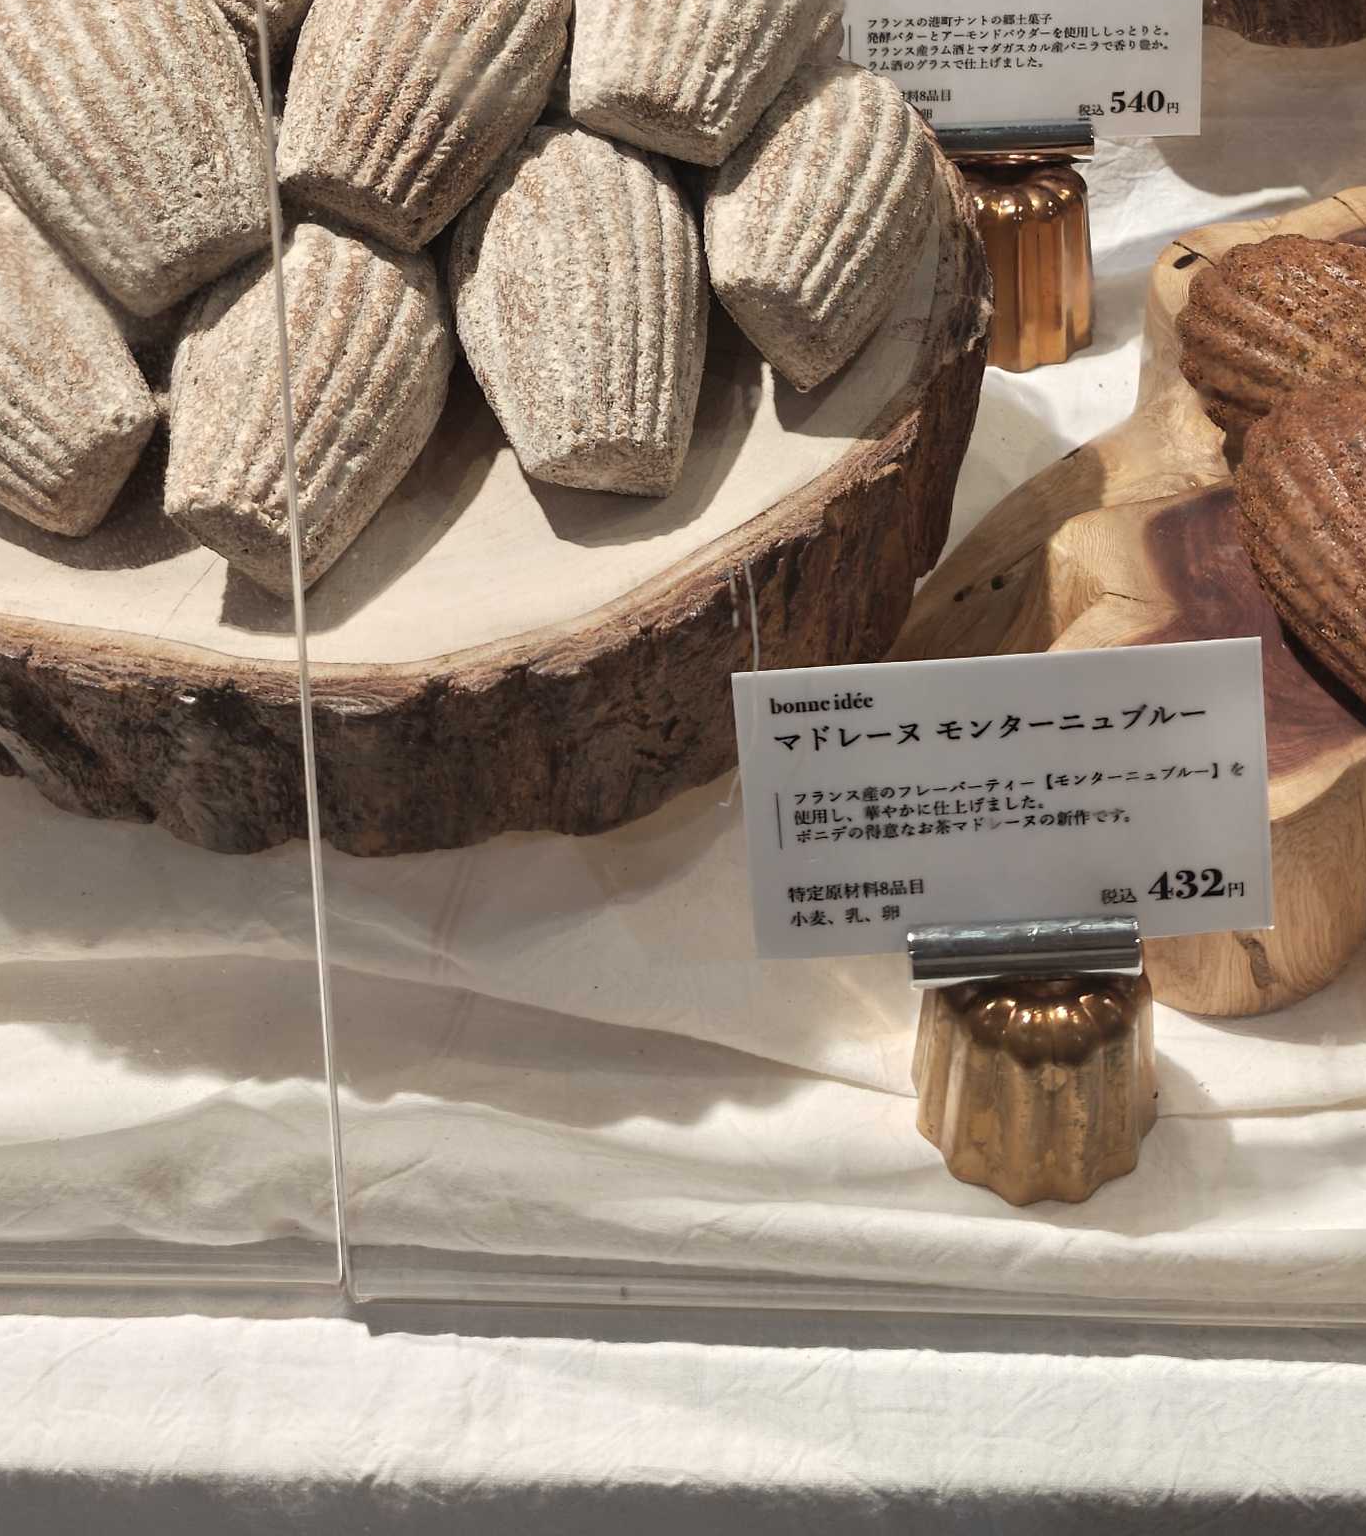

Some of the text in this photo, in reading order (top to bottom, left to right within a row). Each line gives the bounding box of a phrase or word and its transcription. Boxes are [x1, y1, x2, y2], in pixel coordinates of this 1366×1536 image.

[868, 13, 1052, 29] フランスの港町ナントの郷土菓子
[869, 57, 1042, 73] ラム酒のグラスで仕上げました。
[1078, 104, 1104, 117] 税込
[770, 693, 873, 714] bonne idée
[774, 705, 1205, 751] マドレーヌ モンターニュブルー
[794, 795, 1043, 826] 使用し、華やかに仕上げました。
[788, 879, 923, 903] 特定原材料8品目
[1101, 888, 1137, 904] 税込
